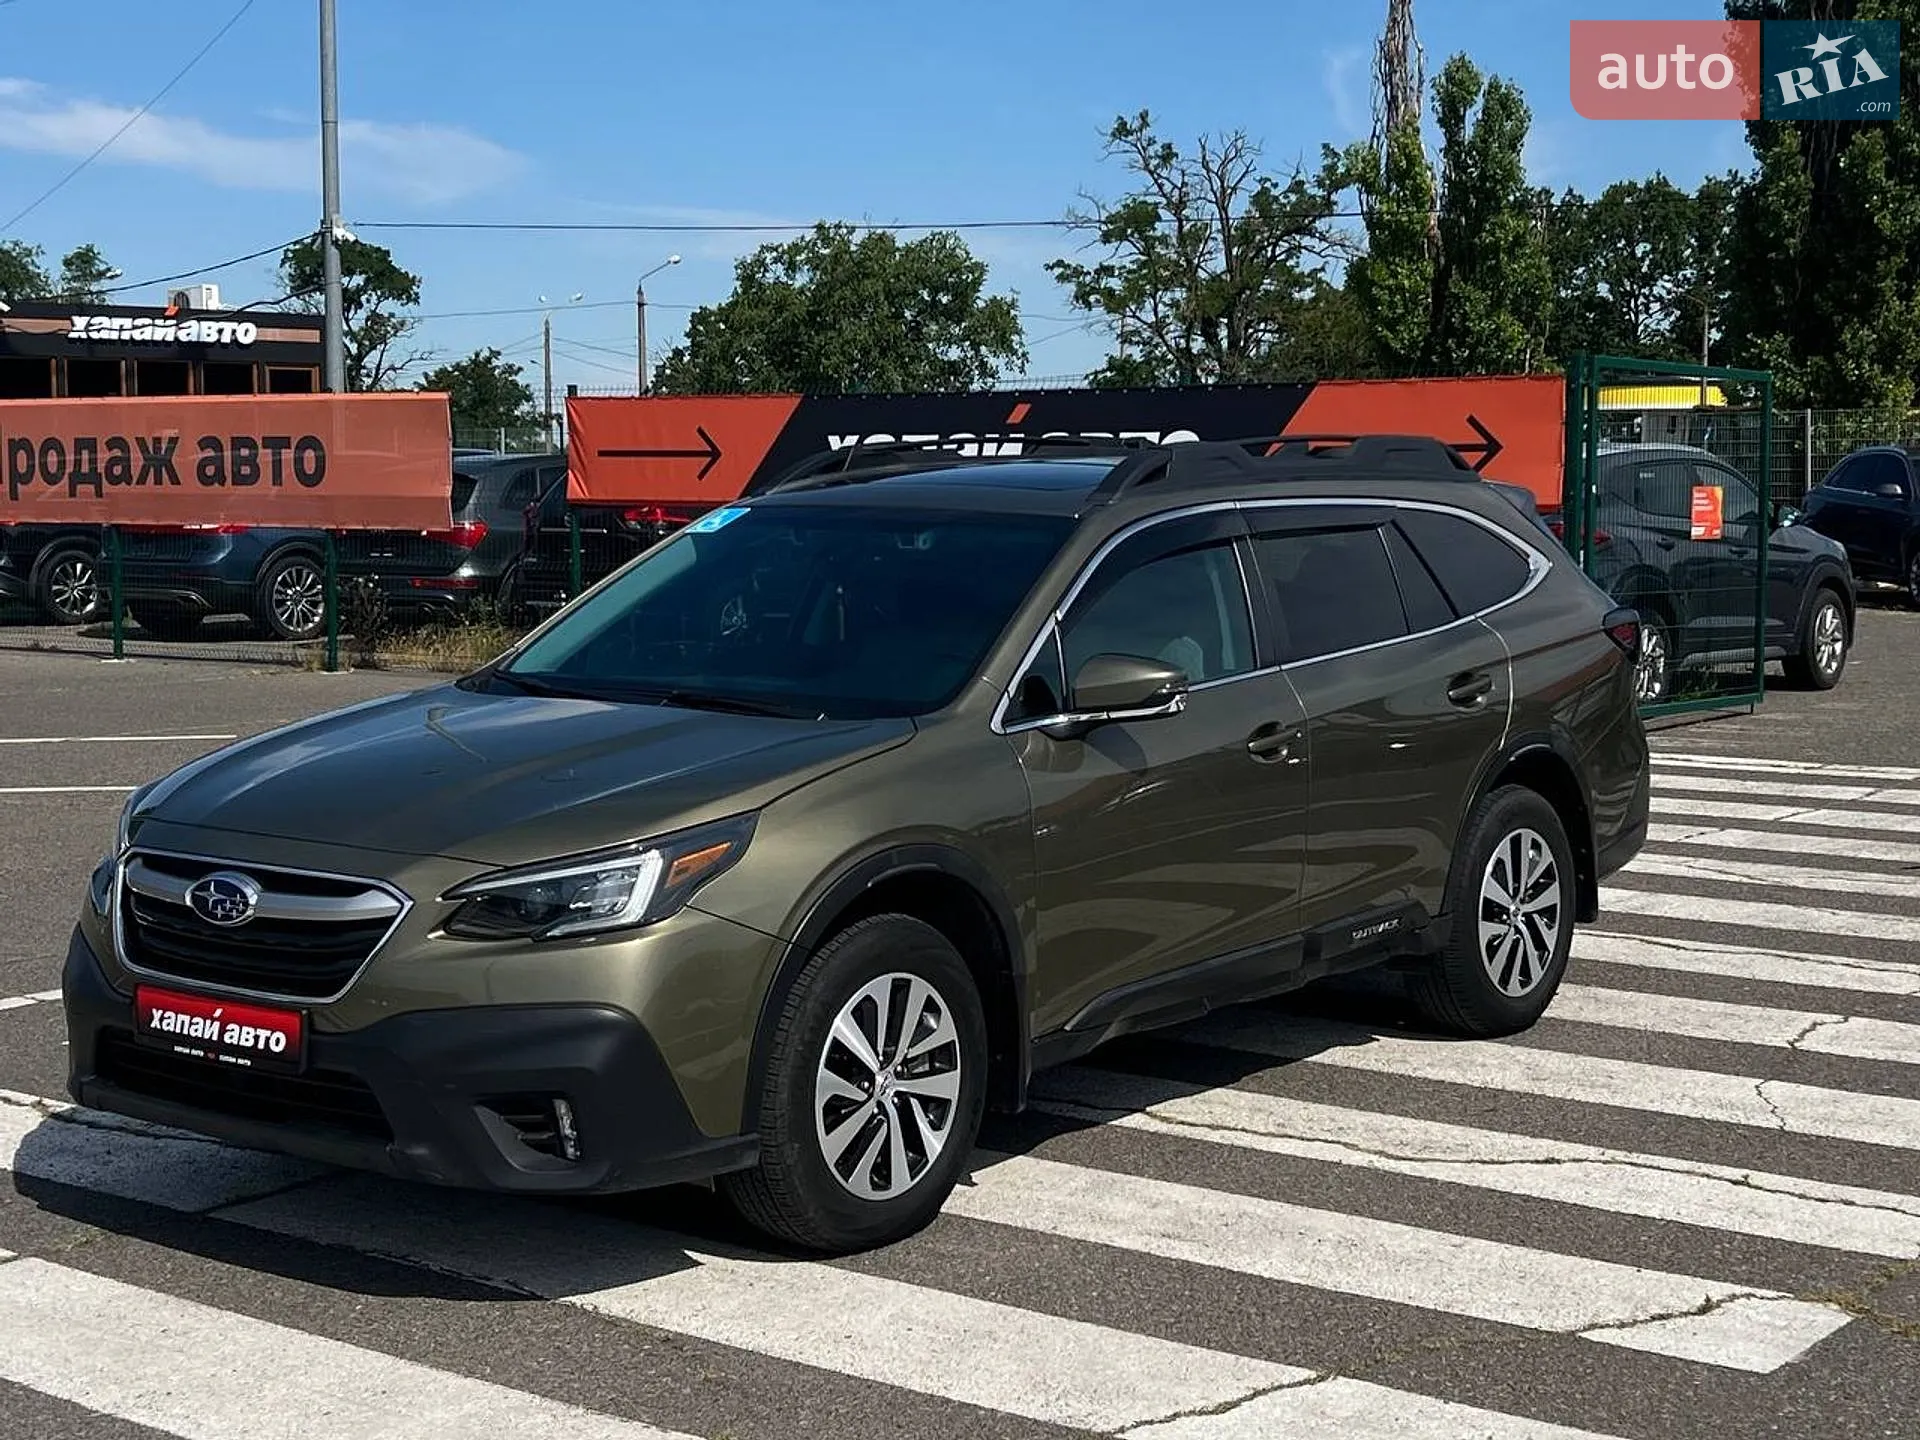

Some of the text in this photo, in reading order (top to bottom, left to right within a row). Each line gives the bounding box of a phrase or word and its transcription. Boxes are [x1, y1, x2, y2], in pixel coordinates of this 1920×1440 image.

[0, 435, 327, 501] родаж авто
[150, 1008, 287, 1053] хапай авто
